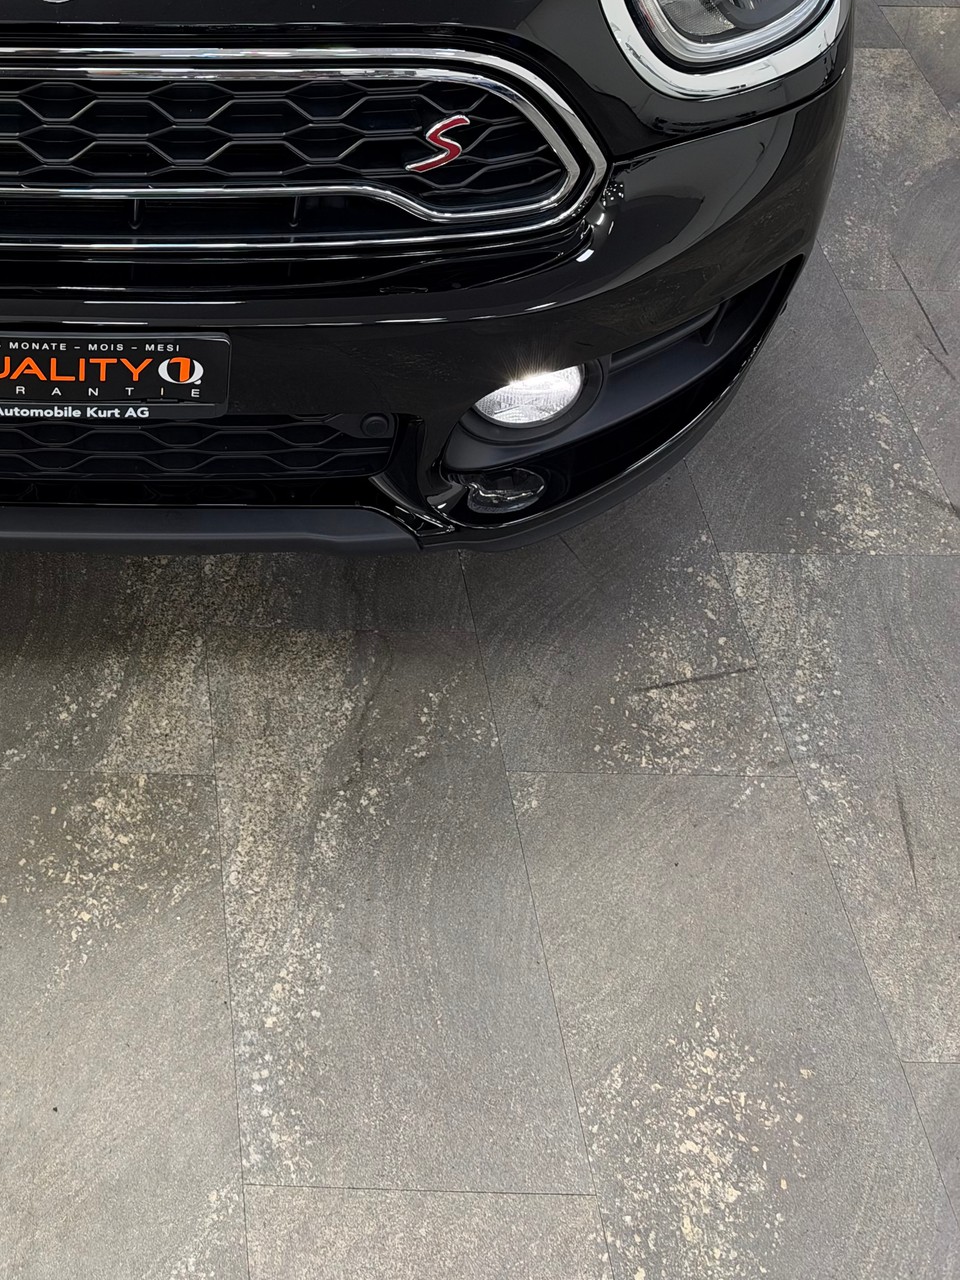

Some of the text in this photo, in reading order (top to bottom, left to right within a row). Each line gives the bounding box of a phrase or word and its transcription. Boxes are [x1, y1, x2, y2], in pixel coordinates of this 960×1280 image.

[405, 114, 471, 173] S
[9, 341, 68, 351] MONATE
[88, 342, 124, 352] MOIS
[145, 343, 181, 352] MESI
[86, 406, 120, 418] Kurt
[124, 407, 150, 418] AG
